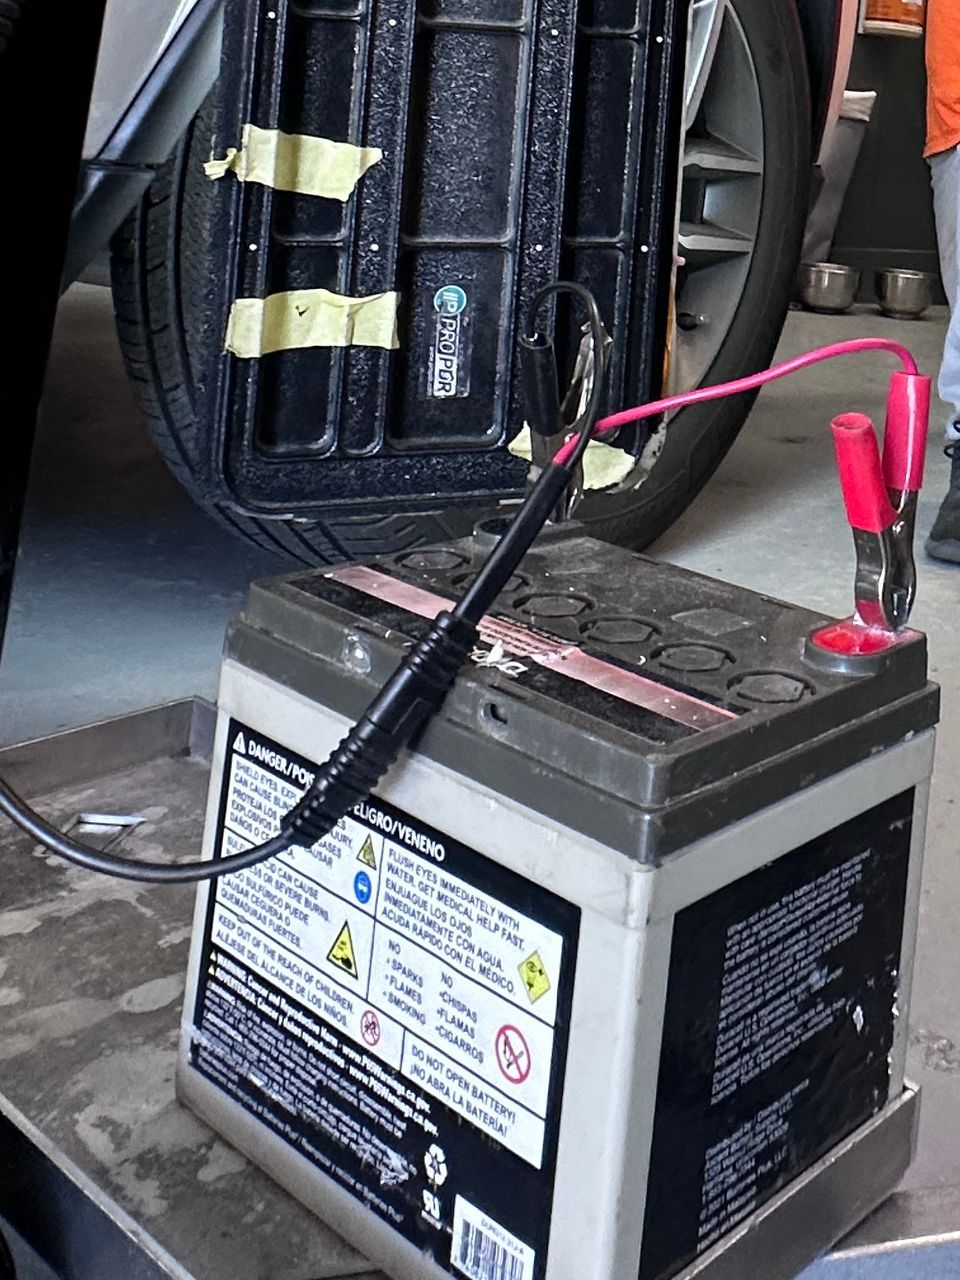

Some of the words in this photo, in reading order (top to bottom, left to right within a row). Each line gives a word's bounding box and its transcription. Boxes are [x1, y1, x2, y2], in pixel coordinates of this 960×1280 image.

[247, 738, 314, 790] DANGER/POIS
[352, 796, 445, 864] ELIGRO/VENENO
[385, 877, 428, 912] ENJUAGUE
[429, 903, 447, 923] LOS
[449, 915, 472, 938] OJOS
[388, 847, 413, 871] FLUSH
[415, 863, 437, 884] EYES
[439, 876, 495, 918] IMMEDIATELY
[497, 910, 519, 931] WITH
[417, 879, 434, 899] GET
[436, 890, 474, 922] MEDICAL
[476, 913, 499, 936] HELP
[218, 912, 236, 933] KEEP
[236, 925, 250, 943] OUT
[251, 935, 261, 950] OF
[262, 942, 275, 960] THE
[277, 952, 302, 978] REACH
[304, 970, 314, 986] OF
[381, 905, 410, 932] ACUDA
[411, 922, 442, 952] RÁPIDO
[444, 943, 462, 964] CON
[465, 956, 475, 972] EL
[383, 891, 453, 942] INMEDIATAMENTE
[455, 934, 475, 955] CON
[388, 939, 400, 955] NO
[246, 948, 259, 966] DEL
[260, 958, 293, 989] ALCANCE
[295, 981, 306, 998] DE
[307, 990, 321, 1009] LOS
[389, 975, 422, 1005] FLAMES
[391, 958, 423, 987] SPARKS
[440, 972, 453, 989] NO
[387, 990, 426, 1026] SMOKING
[439, 1007, 475, 1039] FLAMAS
[441, 992, 477, 1024] CHISPAS
[438, 1025, 484, 1064] CIGARROS
[411, 1044, 424, 1063] DO
[425, 1054, 444, 1076] NOT
[445, 1067, 470, 1093] OPEN
[471, 1084, 515, 1124] BATTERY!
[426, 1073, 450, 1099] ABRA
[452, 1091, 464, 1109] LA
[465, 1097, 507, 1138] BATERÍA!
